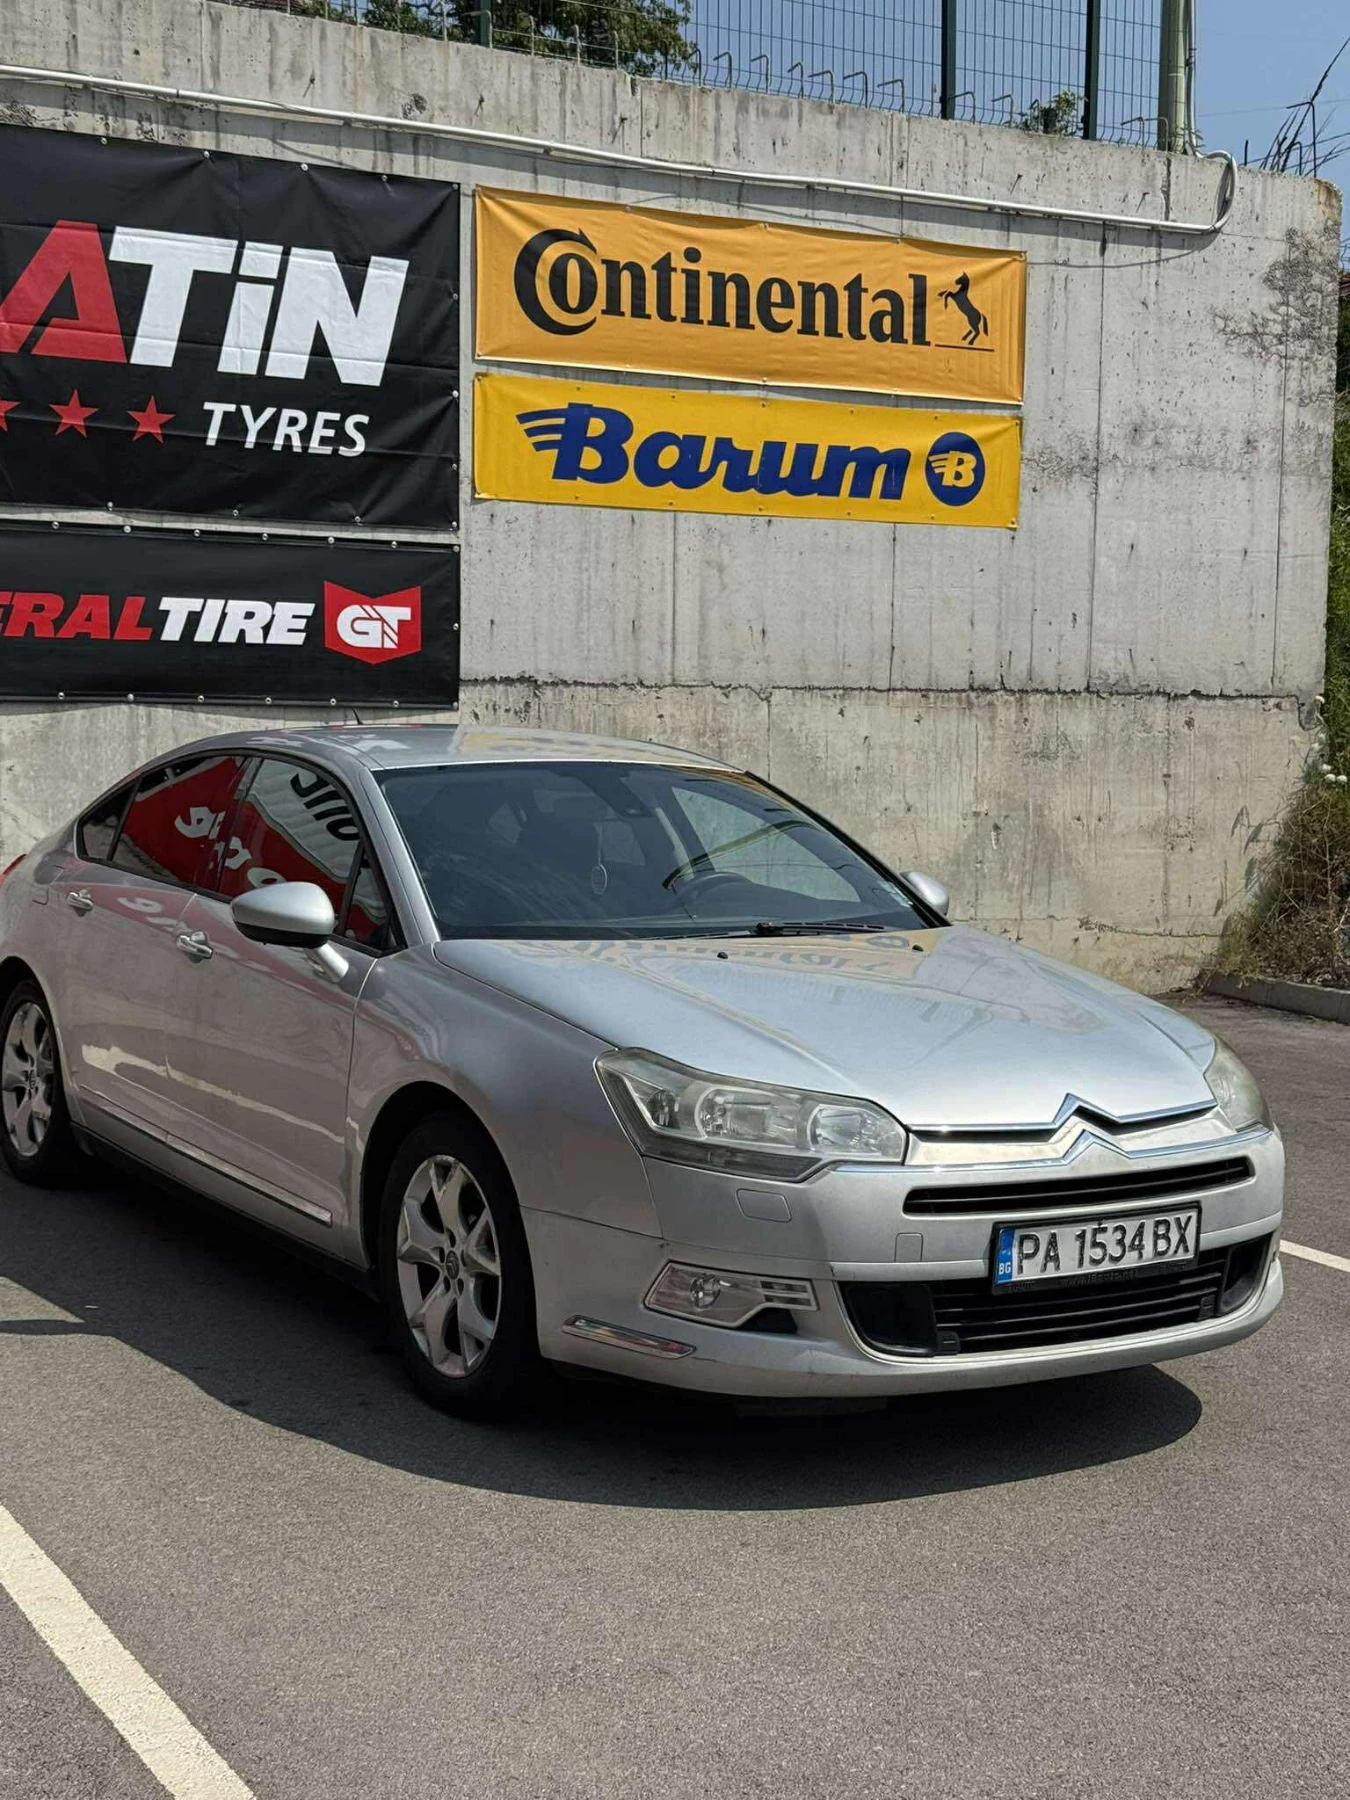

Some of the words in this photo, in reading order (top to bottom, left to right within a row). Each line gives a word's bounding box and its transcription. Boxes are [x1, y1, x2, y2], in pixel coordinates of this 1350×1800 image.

[514, 228, 930, 346] Continental
[203, 401, 369, 457] TYRES
[515, 403, 911, 500] Barum
[337, 604, 411, 649] GT
[998, 1262, 1012, 1275] BG
[1016, 1232, 1061, 1275] PA
[1075, 1220, 1147, 1268] 1534
[1152, 1215, 1192, 1257] BX
